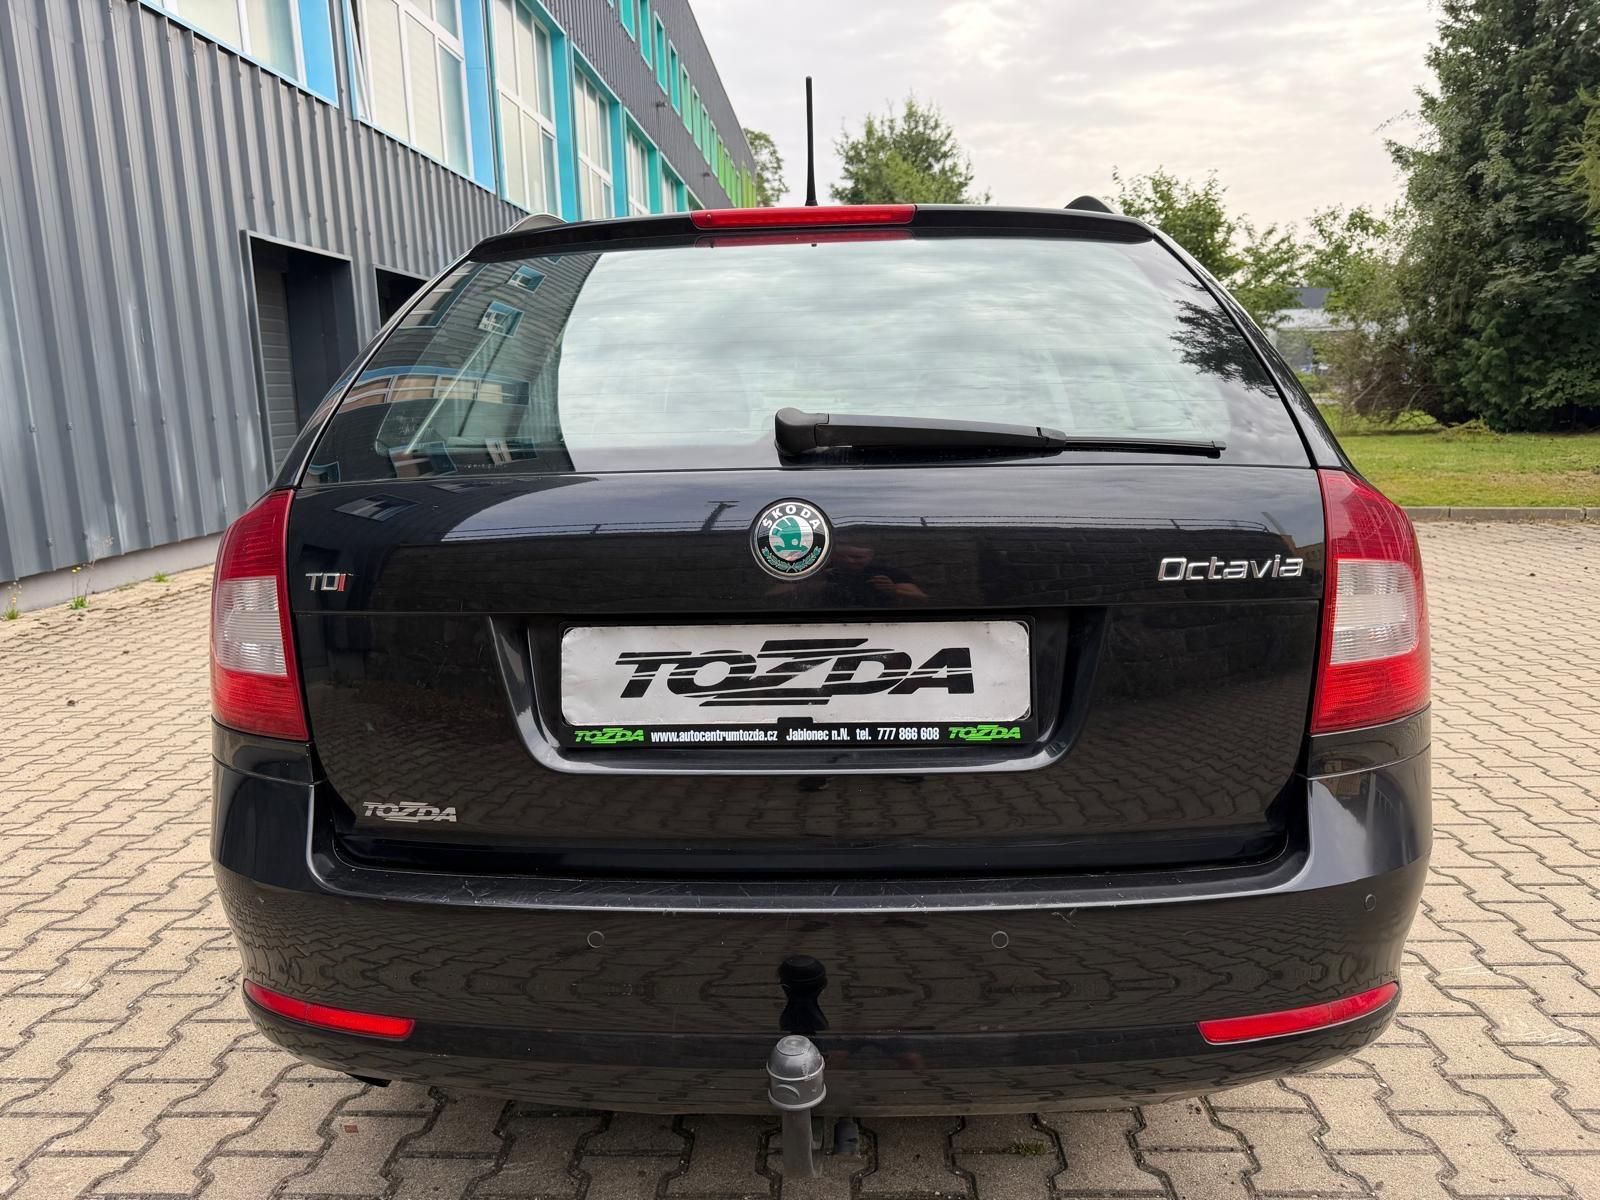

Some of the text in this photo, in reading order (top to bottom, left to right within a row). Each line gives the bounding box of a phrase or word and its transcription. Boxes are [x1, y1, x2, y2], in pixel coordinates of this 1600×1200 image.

[1158, 554, 1303, 581] Octavia
[305, 573, 347, 591] TDI
[614, 638, 974, 707] TOZDA
[575, 725, 1021, 744] TOZDA www.autocentrumtozda.cz Jablonec n.N. tel. 777 866 608 TOZDA
[363, 801, 457, 823] TOZDA
